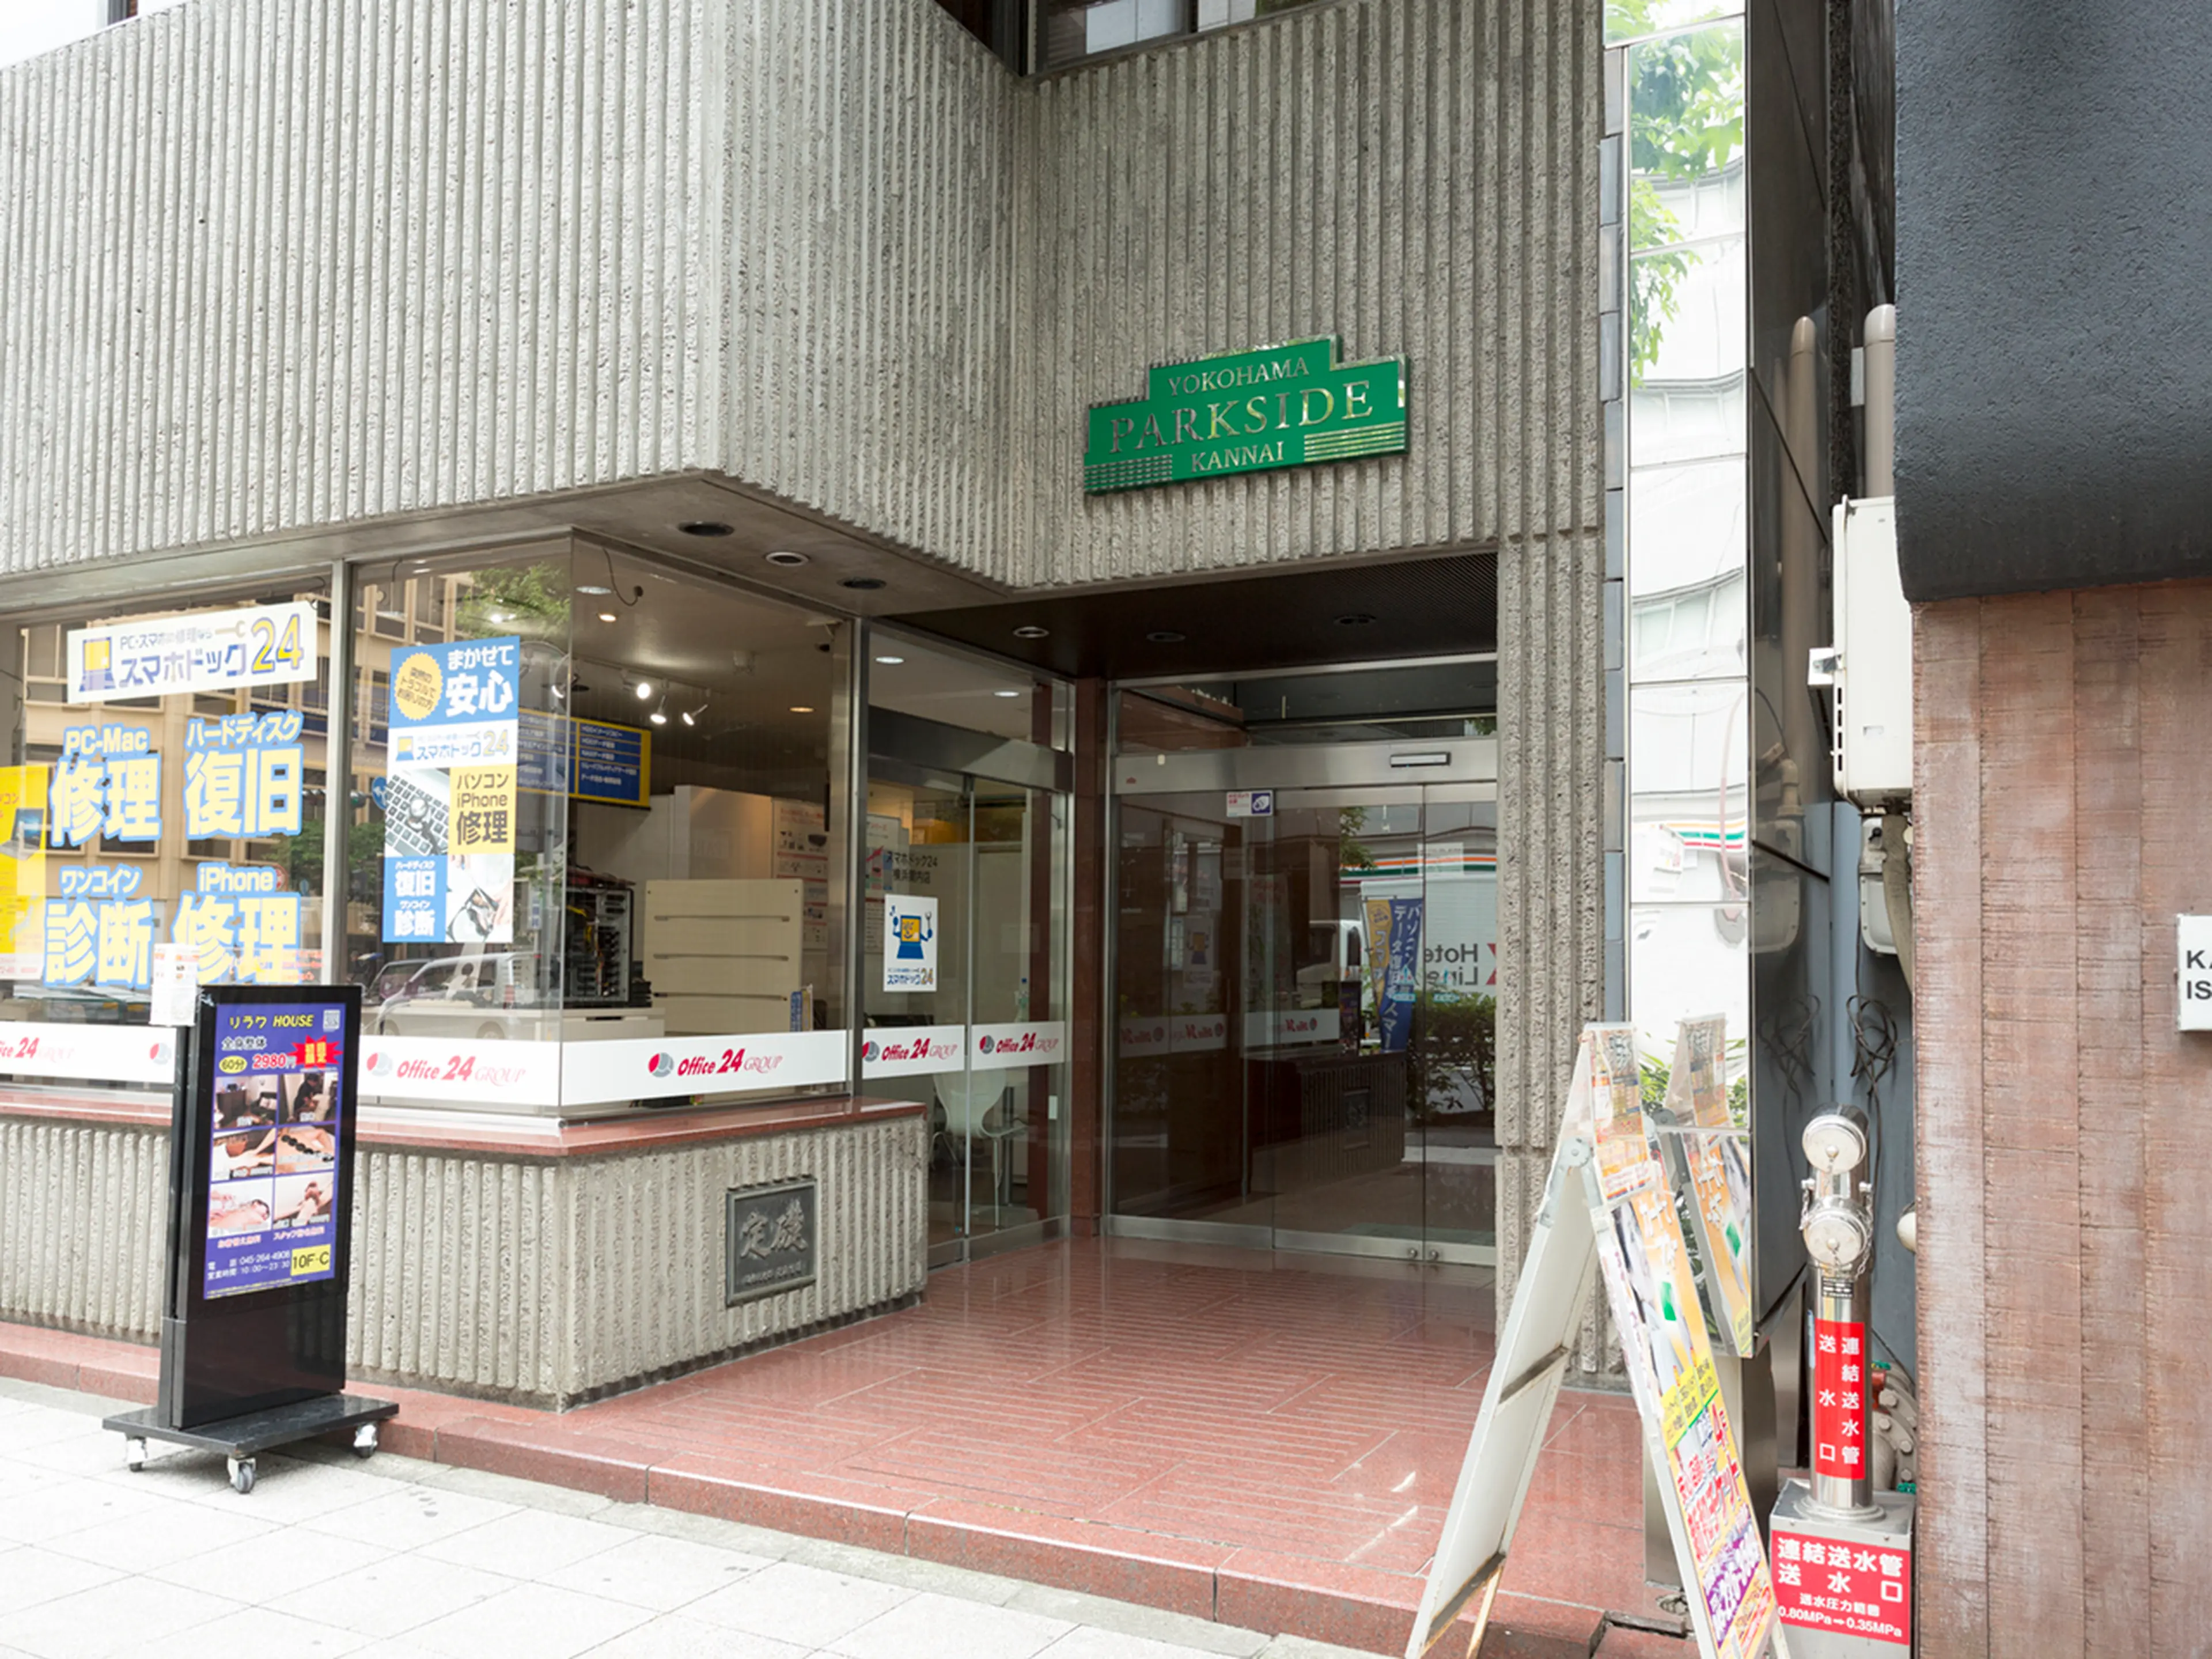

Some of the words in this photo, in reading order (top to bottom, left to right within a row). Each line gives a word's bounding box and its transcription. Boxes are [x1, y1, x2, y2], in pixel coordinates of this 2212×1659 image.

[1167, 357, 1310, 397] YOKOHAMA
[1109, 380, 1374, 454] PARKSIDE
[1190, 441, 1285, 474] KANNAI
[448, 645, 514, 671] まかせて
[446, 669, 514, 717] 安心
[65, 725, 149, 755] PC-Mac
[186, 711, 303, 748] ハードディスク
[185, 747, 302, 838] 復旧
[456, 774, 509, 790] パソコン
[51, 755, 161, 846] 修理
[457, 793, 508, 808] iPhone
[456, 810, 508, 846] 修理
[887, 851, 938, 868] スマホドック24
[60, 865, 141, 895] ワンコイン
[198, 865, 275, 892] iPhone
[395, 871, 435, 897] 復旧
[394, 909, 435, 937] 診断
[46, 897, 153, 987] 診断
[173, 893, 300, 984] 修理
[2187, 950, 2212, 969] K
[230, 1015, 268, 1029] リラク
[272, 1014, 315, 1028] HOUSE
[15, 1037, 40, 1059] 24
[881, 1044, 910, 1060] Office
[910, 1037, 931, 1060] 24
[929, 1044, 958, 1060] GROUP
[995, 1038, 1020, 1054] Office
[1019, 1032, 1037, 1053] 24
[1035, 1038, 1059, 1054] GROUP
[396, 1059, 441, 1080] Office
[441, 1055, 476, 1081] 24
[475, 1066, 526, 1086] GROUP
[677, 1055, 717, 1076] Office
[716, 1048, 746, 1074] 24
[744, 1055, 783, 1074] GROUP
[1819, 1334, 1836, 1463] 送水口
[1841, 1336, 1860, 1465] 連結送水管
[1778, 1537, 1903, 1577] 連結送水管
[1778, 1562, 1903, 1603] 送水口
